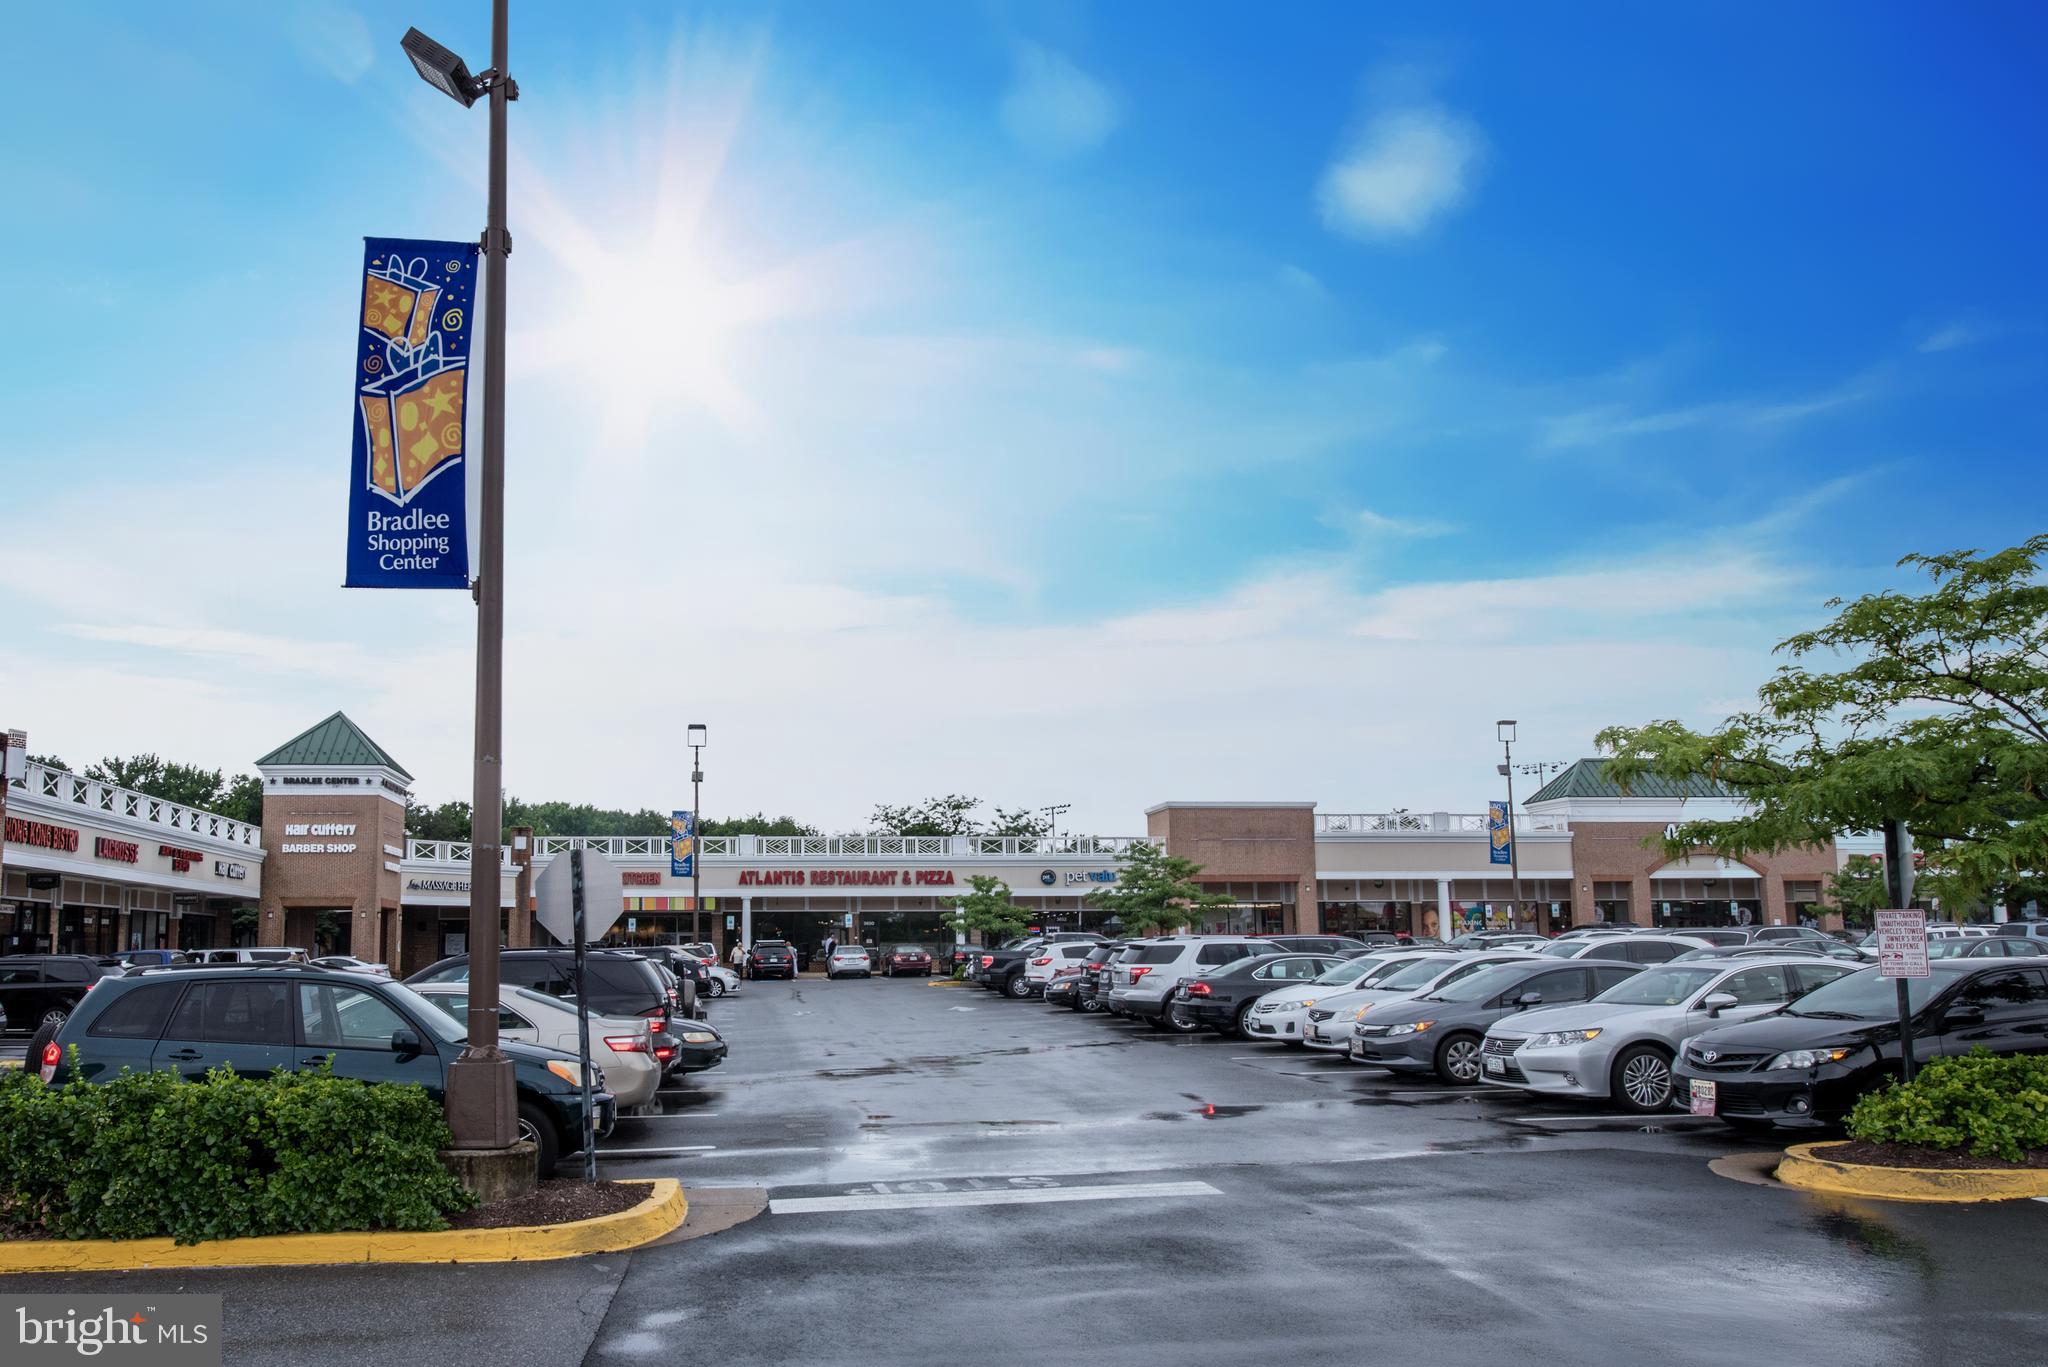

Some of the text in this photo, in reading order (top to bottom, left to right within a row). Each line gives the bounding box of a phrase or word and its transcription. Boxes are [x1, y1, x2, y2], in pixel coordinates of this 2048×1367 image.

[368, 508, 450, 531] Bradlee
[368, 533, 450, 555] Shopping
[379, 554, 440, 570] Center
[283, 777, 359, 785] BRADLEE CENTER
[5, 816, 80, 853] HONG KONG BISTRO
[285, 824, 309, 836] Hair
[96, 837, 139, 864] LACROSSE
[282, 843, 357, 853] BARBER SHOP
[420, 880, 457, 891] MASSAGE
[622, 872, 662, 886] KITCHEN
[739, 870, 955, 886] ATLANTIS RESTAURANT & PIZZA
[1065, 870, 1116, 886] pet valu
[843, 1176, 1062, 1196] STOP
